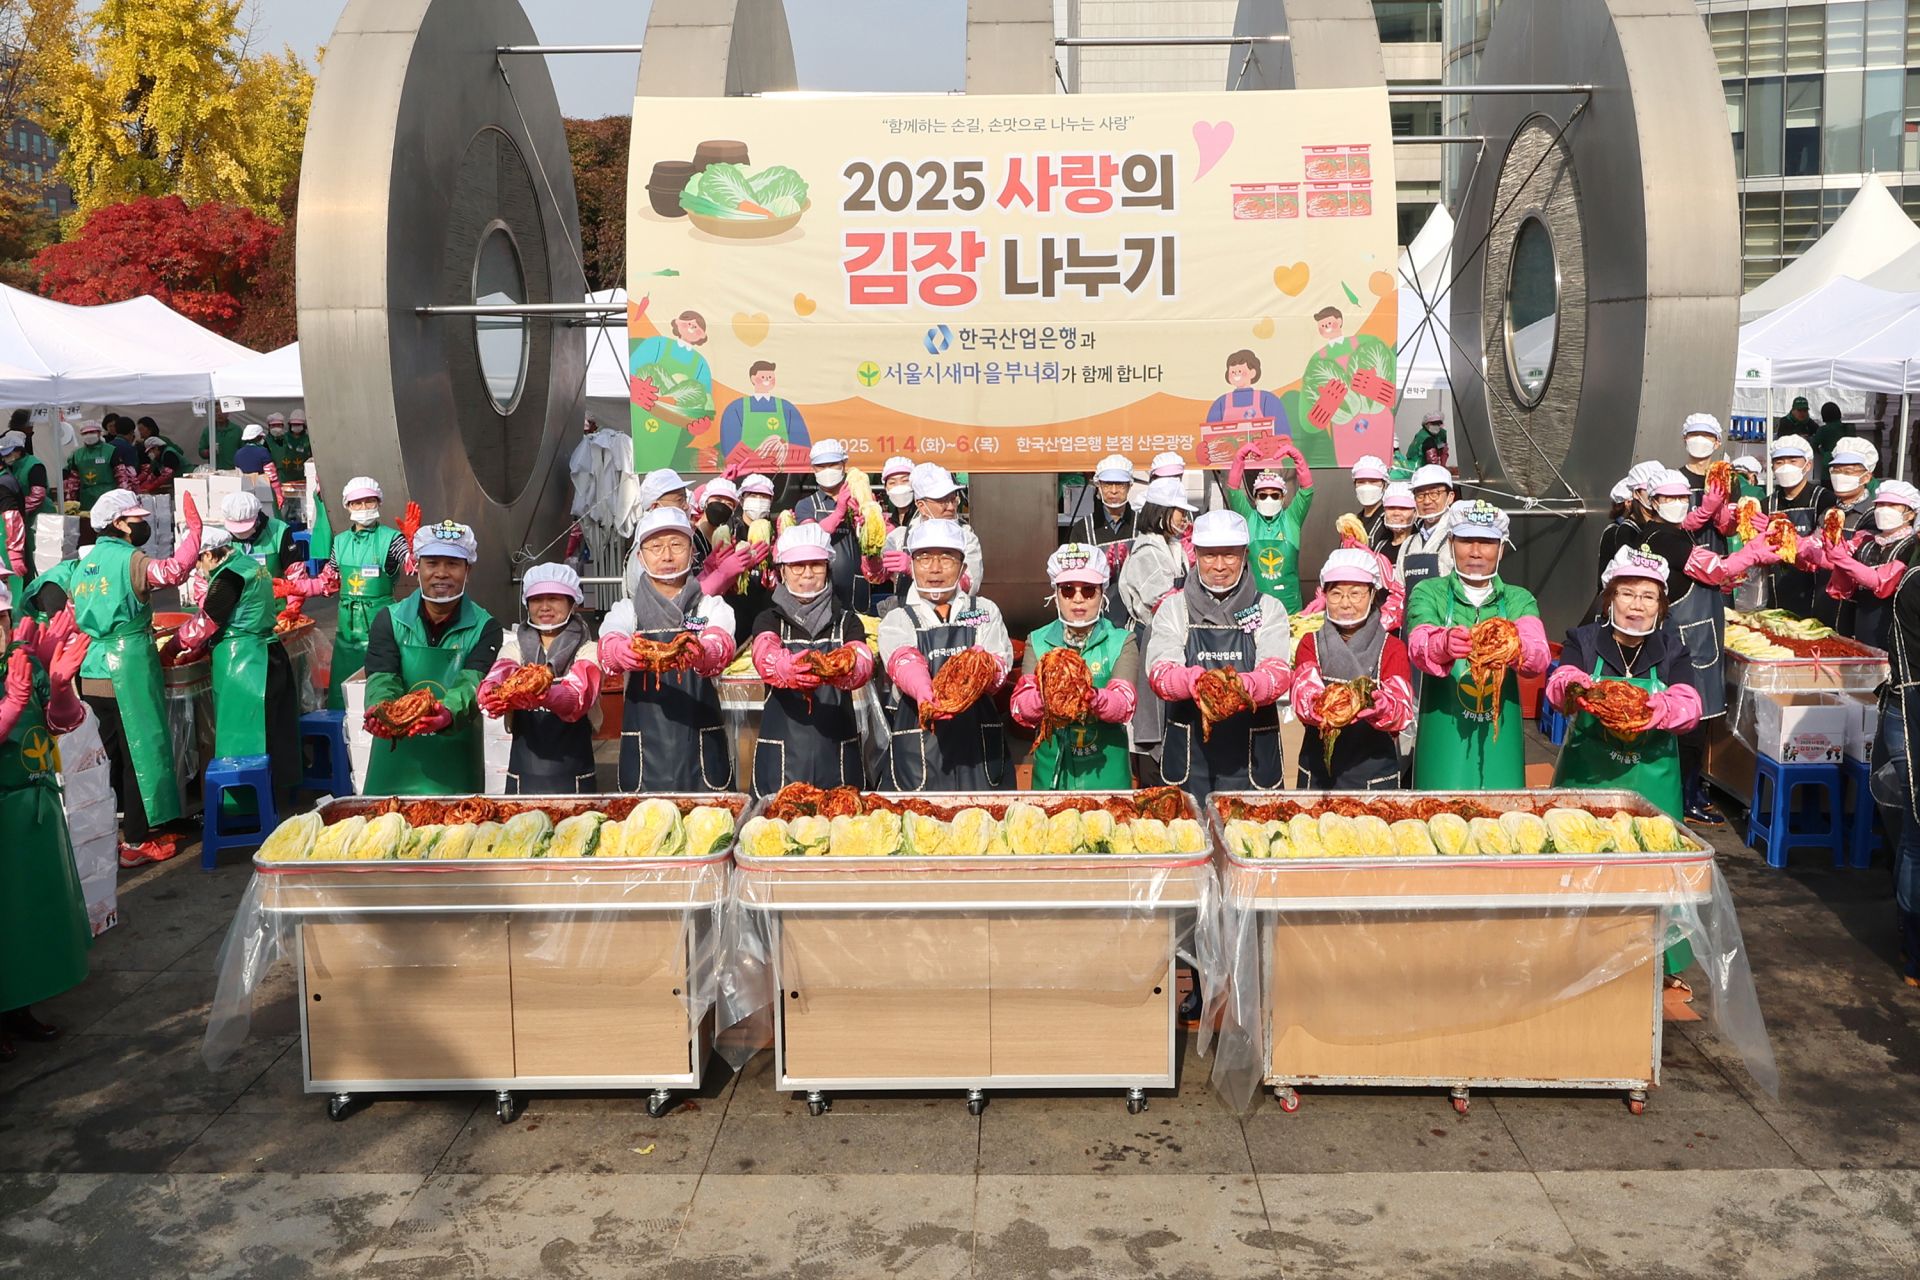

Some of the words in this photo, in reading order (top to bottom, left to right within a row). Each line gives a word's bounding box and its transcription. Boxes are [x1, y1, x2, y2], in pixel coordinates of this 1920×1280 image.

[951, 118, 984, 134] 손길,
[989, 117, 1047, 133] 손맛으로
[1051, 116, 1095, 132] 나누는
[843, 160, 986, 212] 2025
[996, 154, 1175, 213] 사랑의
[843, 231, 986, 307] 김장
[1004, 235, 1176, 298] 나누기
[958, 326, 1097, 350] 한국산업은행과
[883, 361, 1077, 385] 서울시새마을부녀회가
[1081, 364, 1113, 383] 함께
[1116, 363, 1164, 383] 합니다
[838, 438, 873, 453] 025.
[1016, 436, 1102, 453] 한국산업은행
[1105, 435, 1133, 452] 본점
[1137, 434, 1195, 451] 산은광장
[1204, 650, 1243, 661] 한국산업은행
